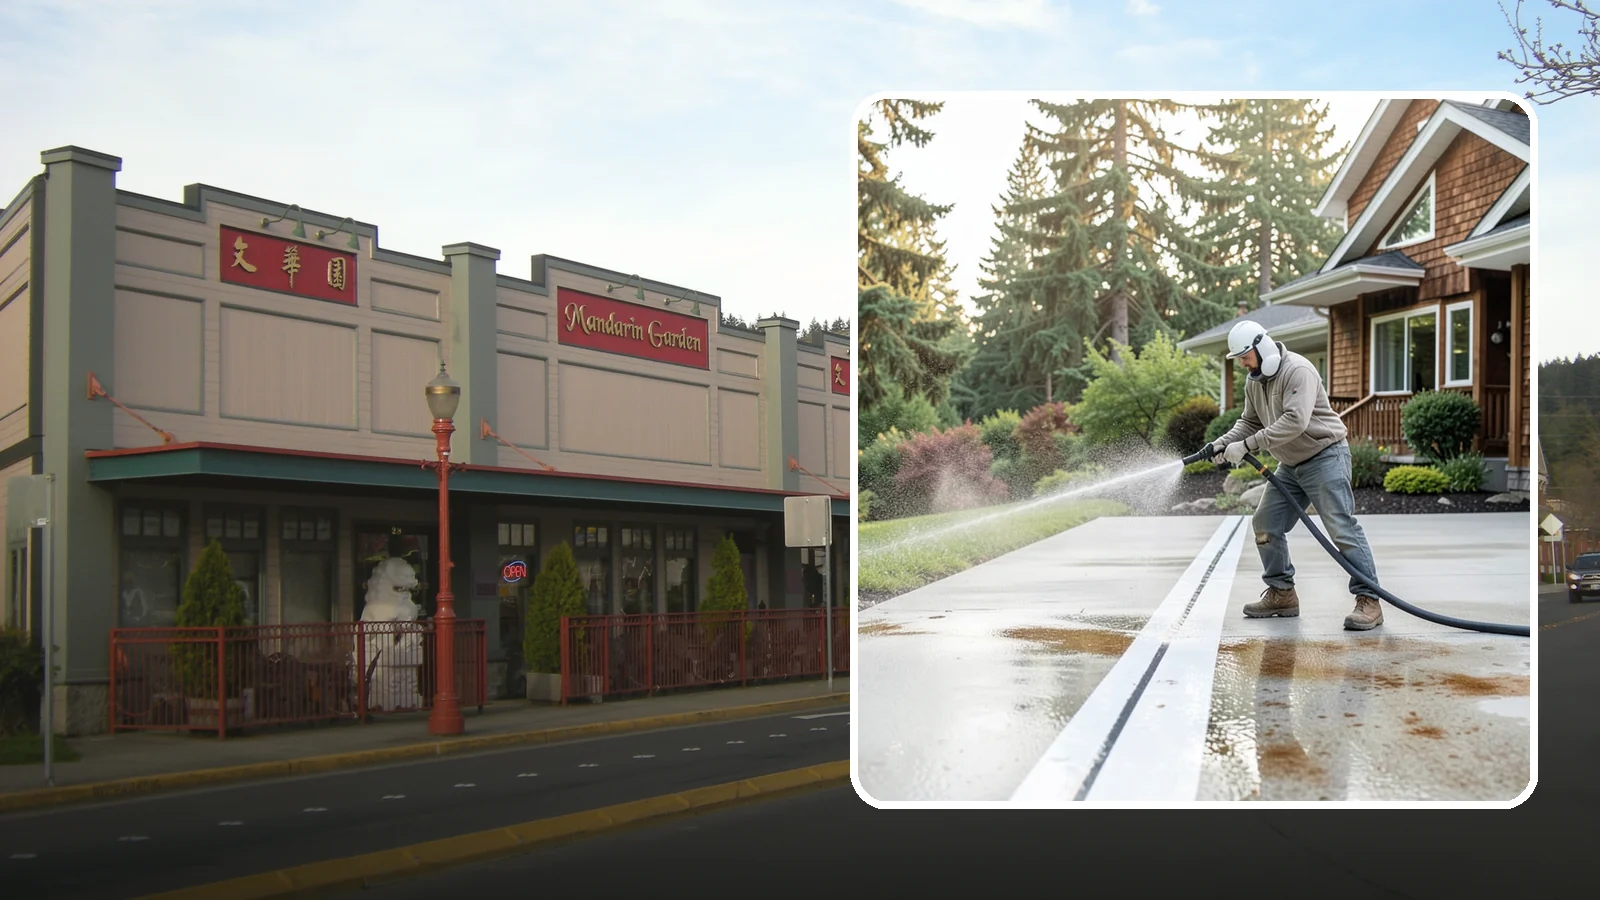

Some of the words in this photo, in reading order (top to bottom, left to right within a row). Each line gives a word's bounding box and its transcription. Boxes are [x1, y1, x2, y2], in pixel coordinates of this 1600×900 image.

[231, 235, 346, 291] 文華園
[564, 302, 644, 341] Mandarin
[648, 320, 701, 352] Garden
[503, 565, 527, 578] OPEN
